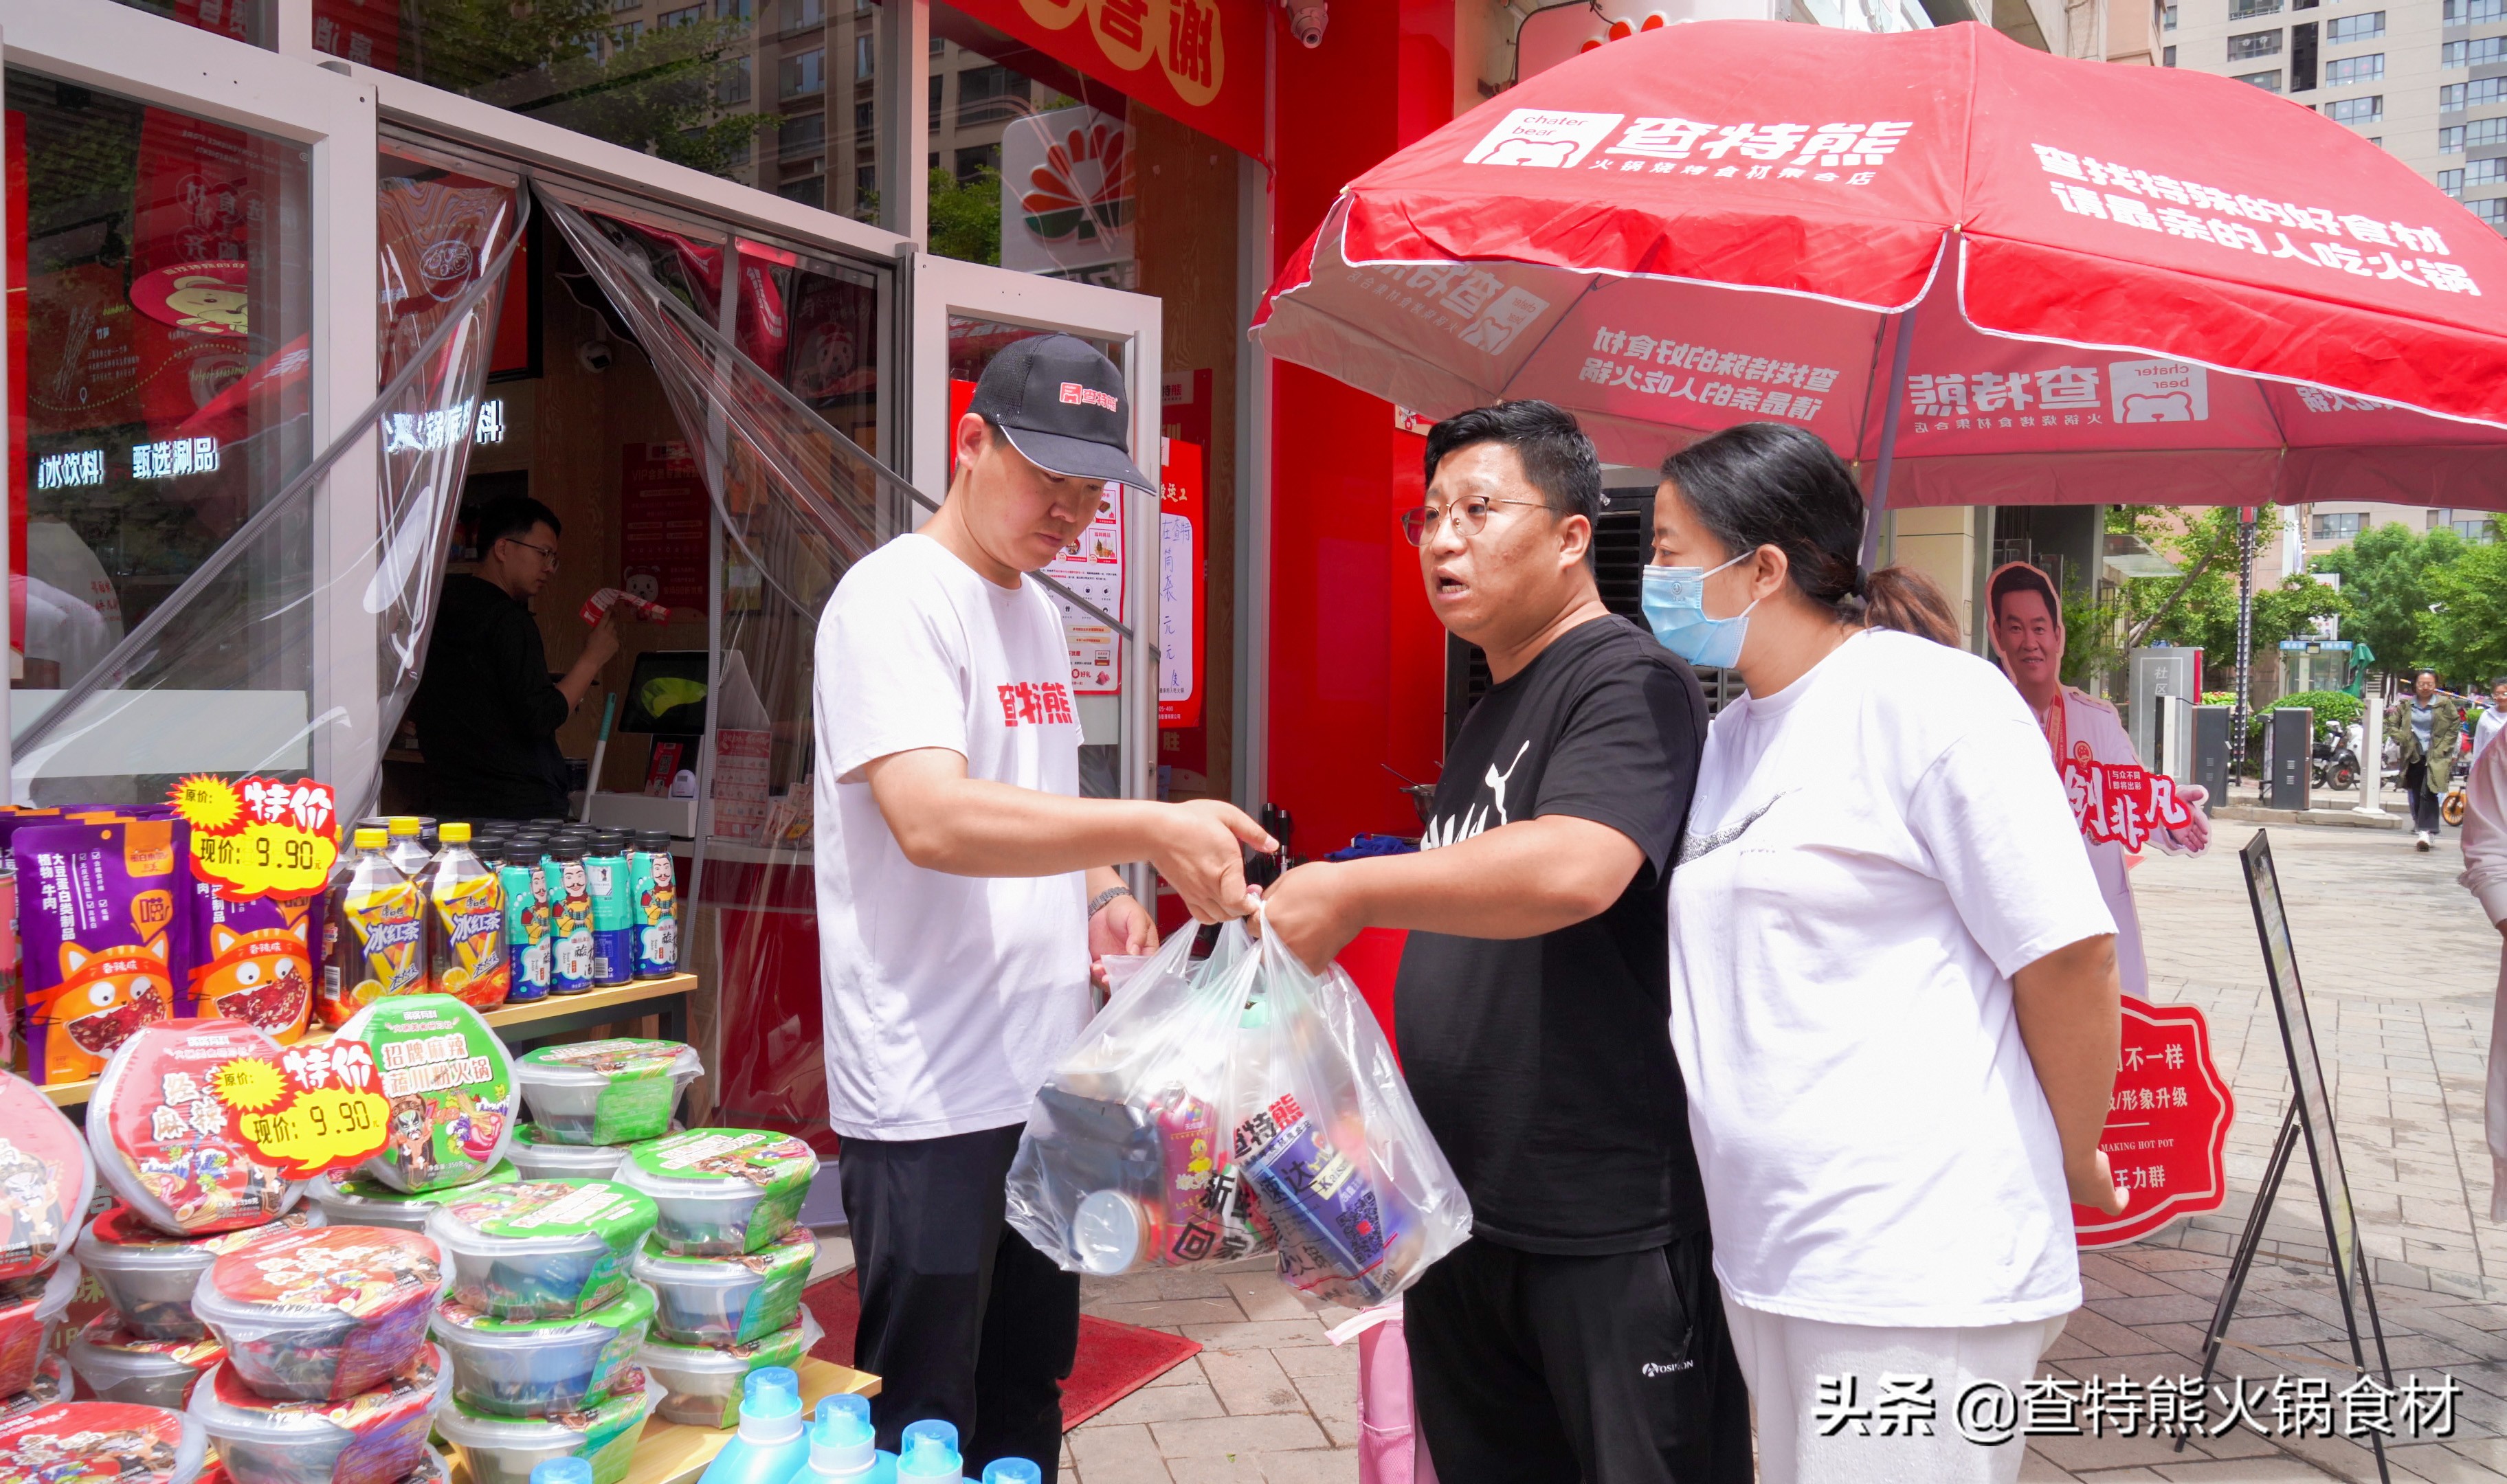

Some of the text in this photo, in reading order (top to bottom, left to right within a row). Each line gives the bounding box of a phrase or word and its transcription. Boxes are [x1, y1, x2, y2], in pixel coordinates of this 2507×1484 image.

[1512, 124, 1559, 139] bear
[1523, 113, 1589, 131] chater
[1605, 116, 1913, 166] 查特熊
[1588, 158, 1875, 186] 火锅烧烤食材集合店
[2031, 142, 2451, 256] 查找特殊的好食材
[2050, 181, 2482, 297] 请最亲的人吃火锅
[1082, 389, 1117, 412] 查特熊
[133, 437, 219, 479] 甄选涮品
[2154, 666, 2168, 695] 社区
[997, 682, 1073, 727] 查特熊
[2112, 770, 2141, 780] 与众不同
[2113, 781, 2142, 791] 即将出彩
[245, 782, 334, 830] 特价
[52, 853, 76, 941] 大豆蛋白类制品
[364, 920, 420, 958] 冰红茶
[451, 911, 501, 947] 冰红茶
[249, 941, 282, 954] 香辣味
[102, 960, 138, 974] 香辣味
[283, 1045, 374, 1090] 特价
[383, 1035, 467, 1068] 招牌麻辣
[380, 1058, 491, 1096] 蔬川粉火锅
[154, 1097, 227, 1141] 麻辣
[316, 1101, 370, 1136] 9.90
[2101, 1138, 2174, 1152] MAKING HOT POT
[2114, 1165, 2165, 1189] 王力群
